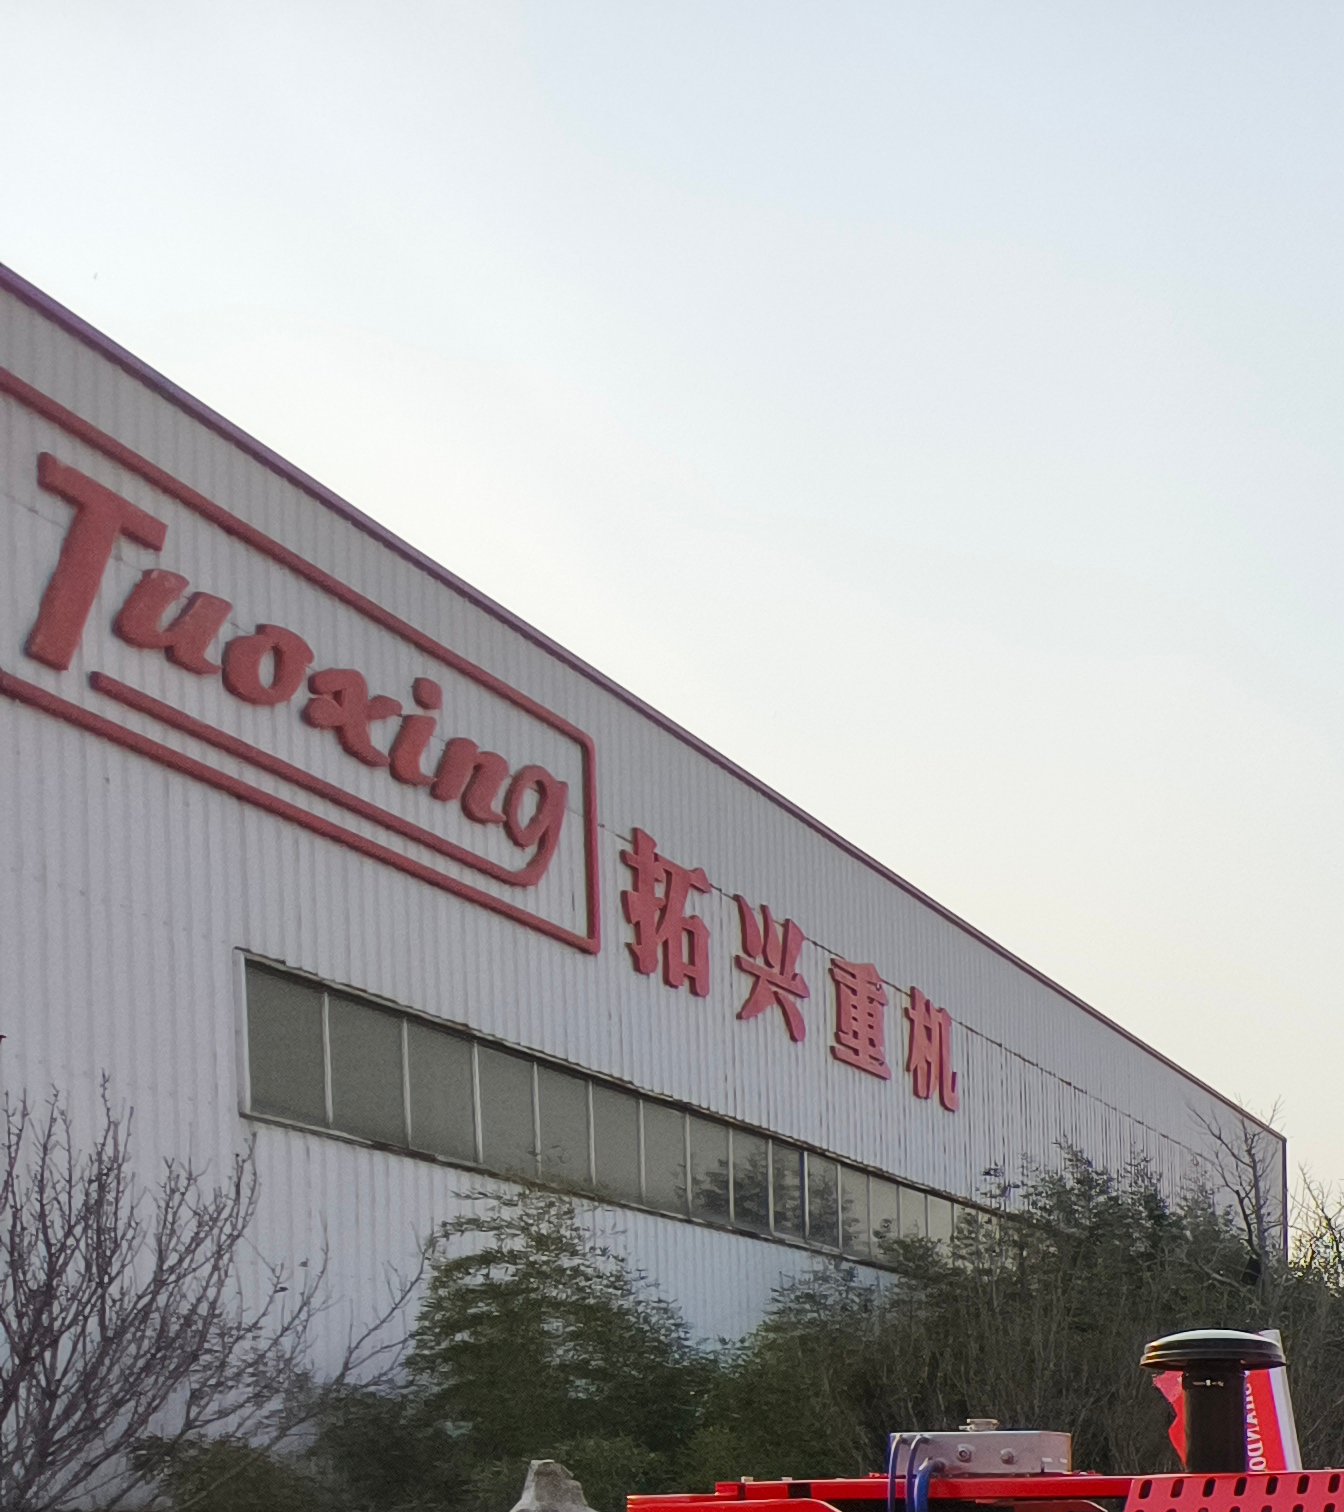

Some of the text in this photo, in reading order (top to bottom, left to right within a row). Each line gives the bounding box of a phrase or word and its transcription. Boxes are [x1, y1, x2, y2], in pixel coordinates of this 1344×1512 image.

[26, 451, 569, 887] Tuoxing
[619, 826, 960, 1113] 拓兴重机
